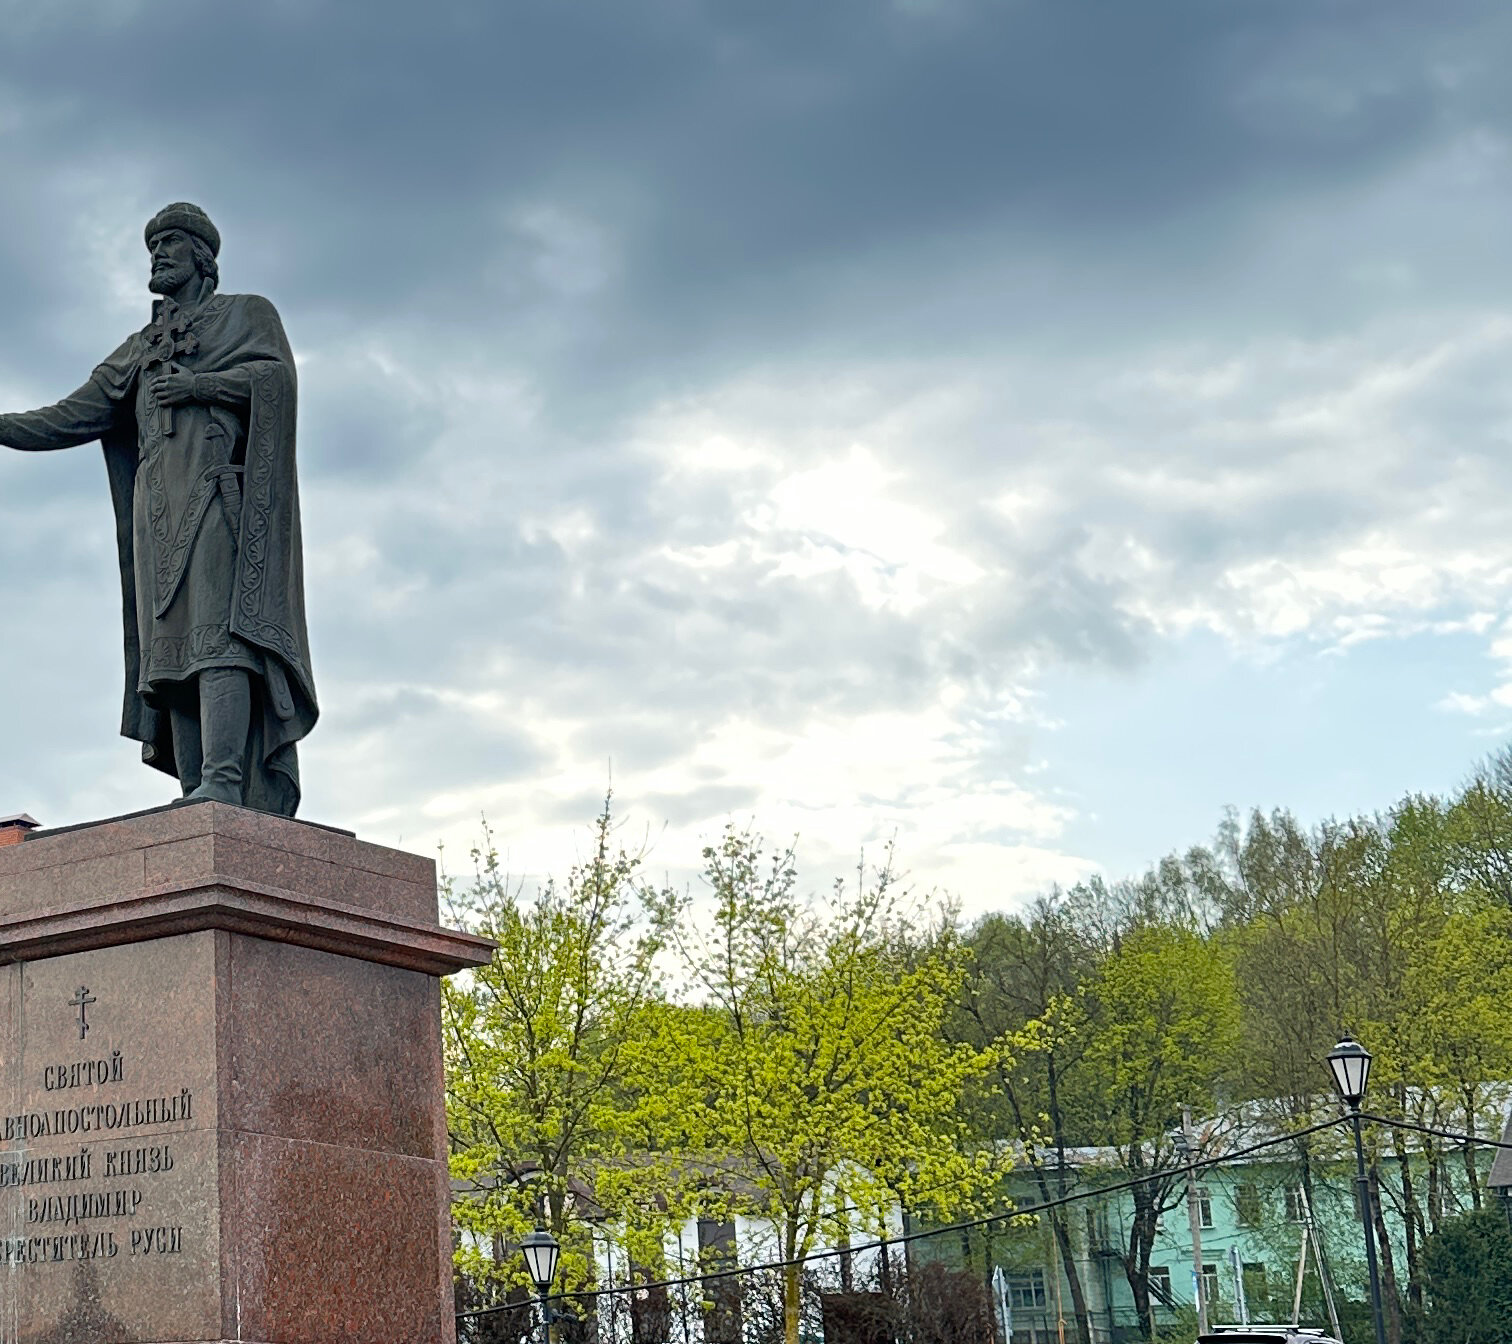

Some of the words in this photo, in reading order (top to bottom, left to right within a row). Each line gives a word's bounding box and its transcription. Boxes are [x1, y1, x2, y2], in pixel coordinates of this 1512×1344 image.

[44, 1051, 124, 1091] СВЯТОЙ
[104, 1146, 174, 1178] КНЯЗЬ
[27, 1190, 142, 1226] ВЛАДИМИР
[130, 1227, 183, 1256] РУСИ
